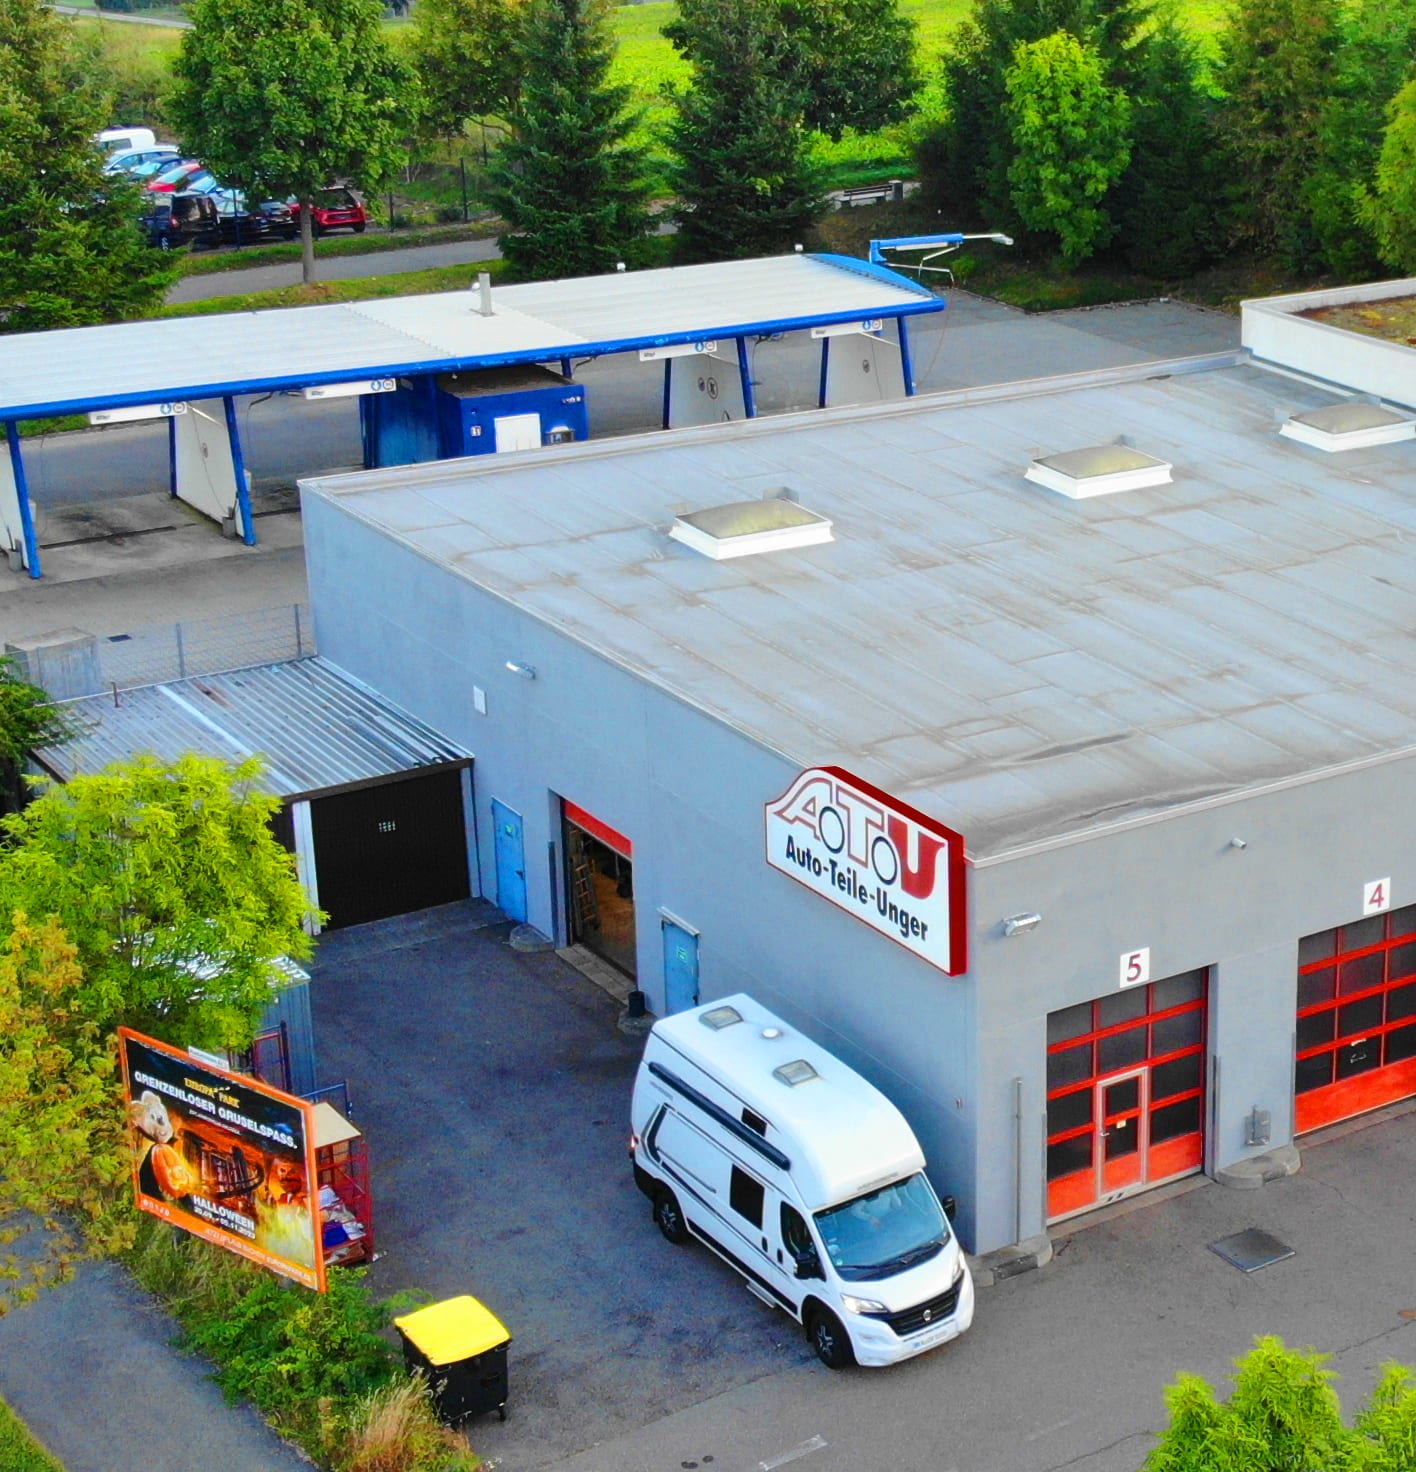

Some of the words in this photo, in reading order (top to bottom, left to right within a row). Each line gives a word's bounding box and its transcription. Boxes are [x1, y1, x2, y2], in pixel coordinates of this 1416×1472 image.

[786, 835, 929, 940] Auto-Teile-Unger
[1368, 882, 1385, 908] 4
[1126, 953, 1142, 982] 5
[134, 1070, 216, 1115] GRENZENLOSER
[218, 1106, 298, 1149] GRUSELSPASS.
[193, 1194, 255, 1231] HALLOWEEN
